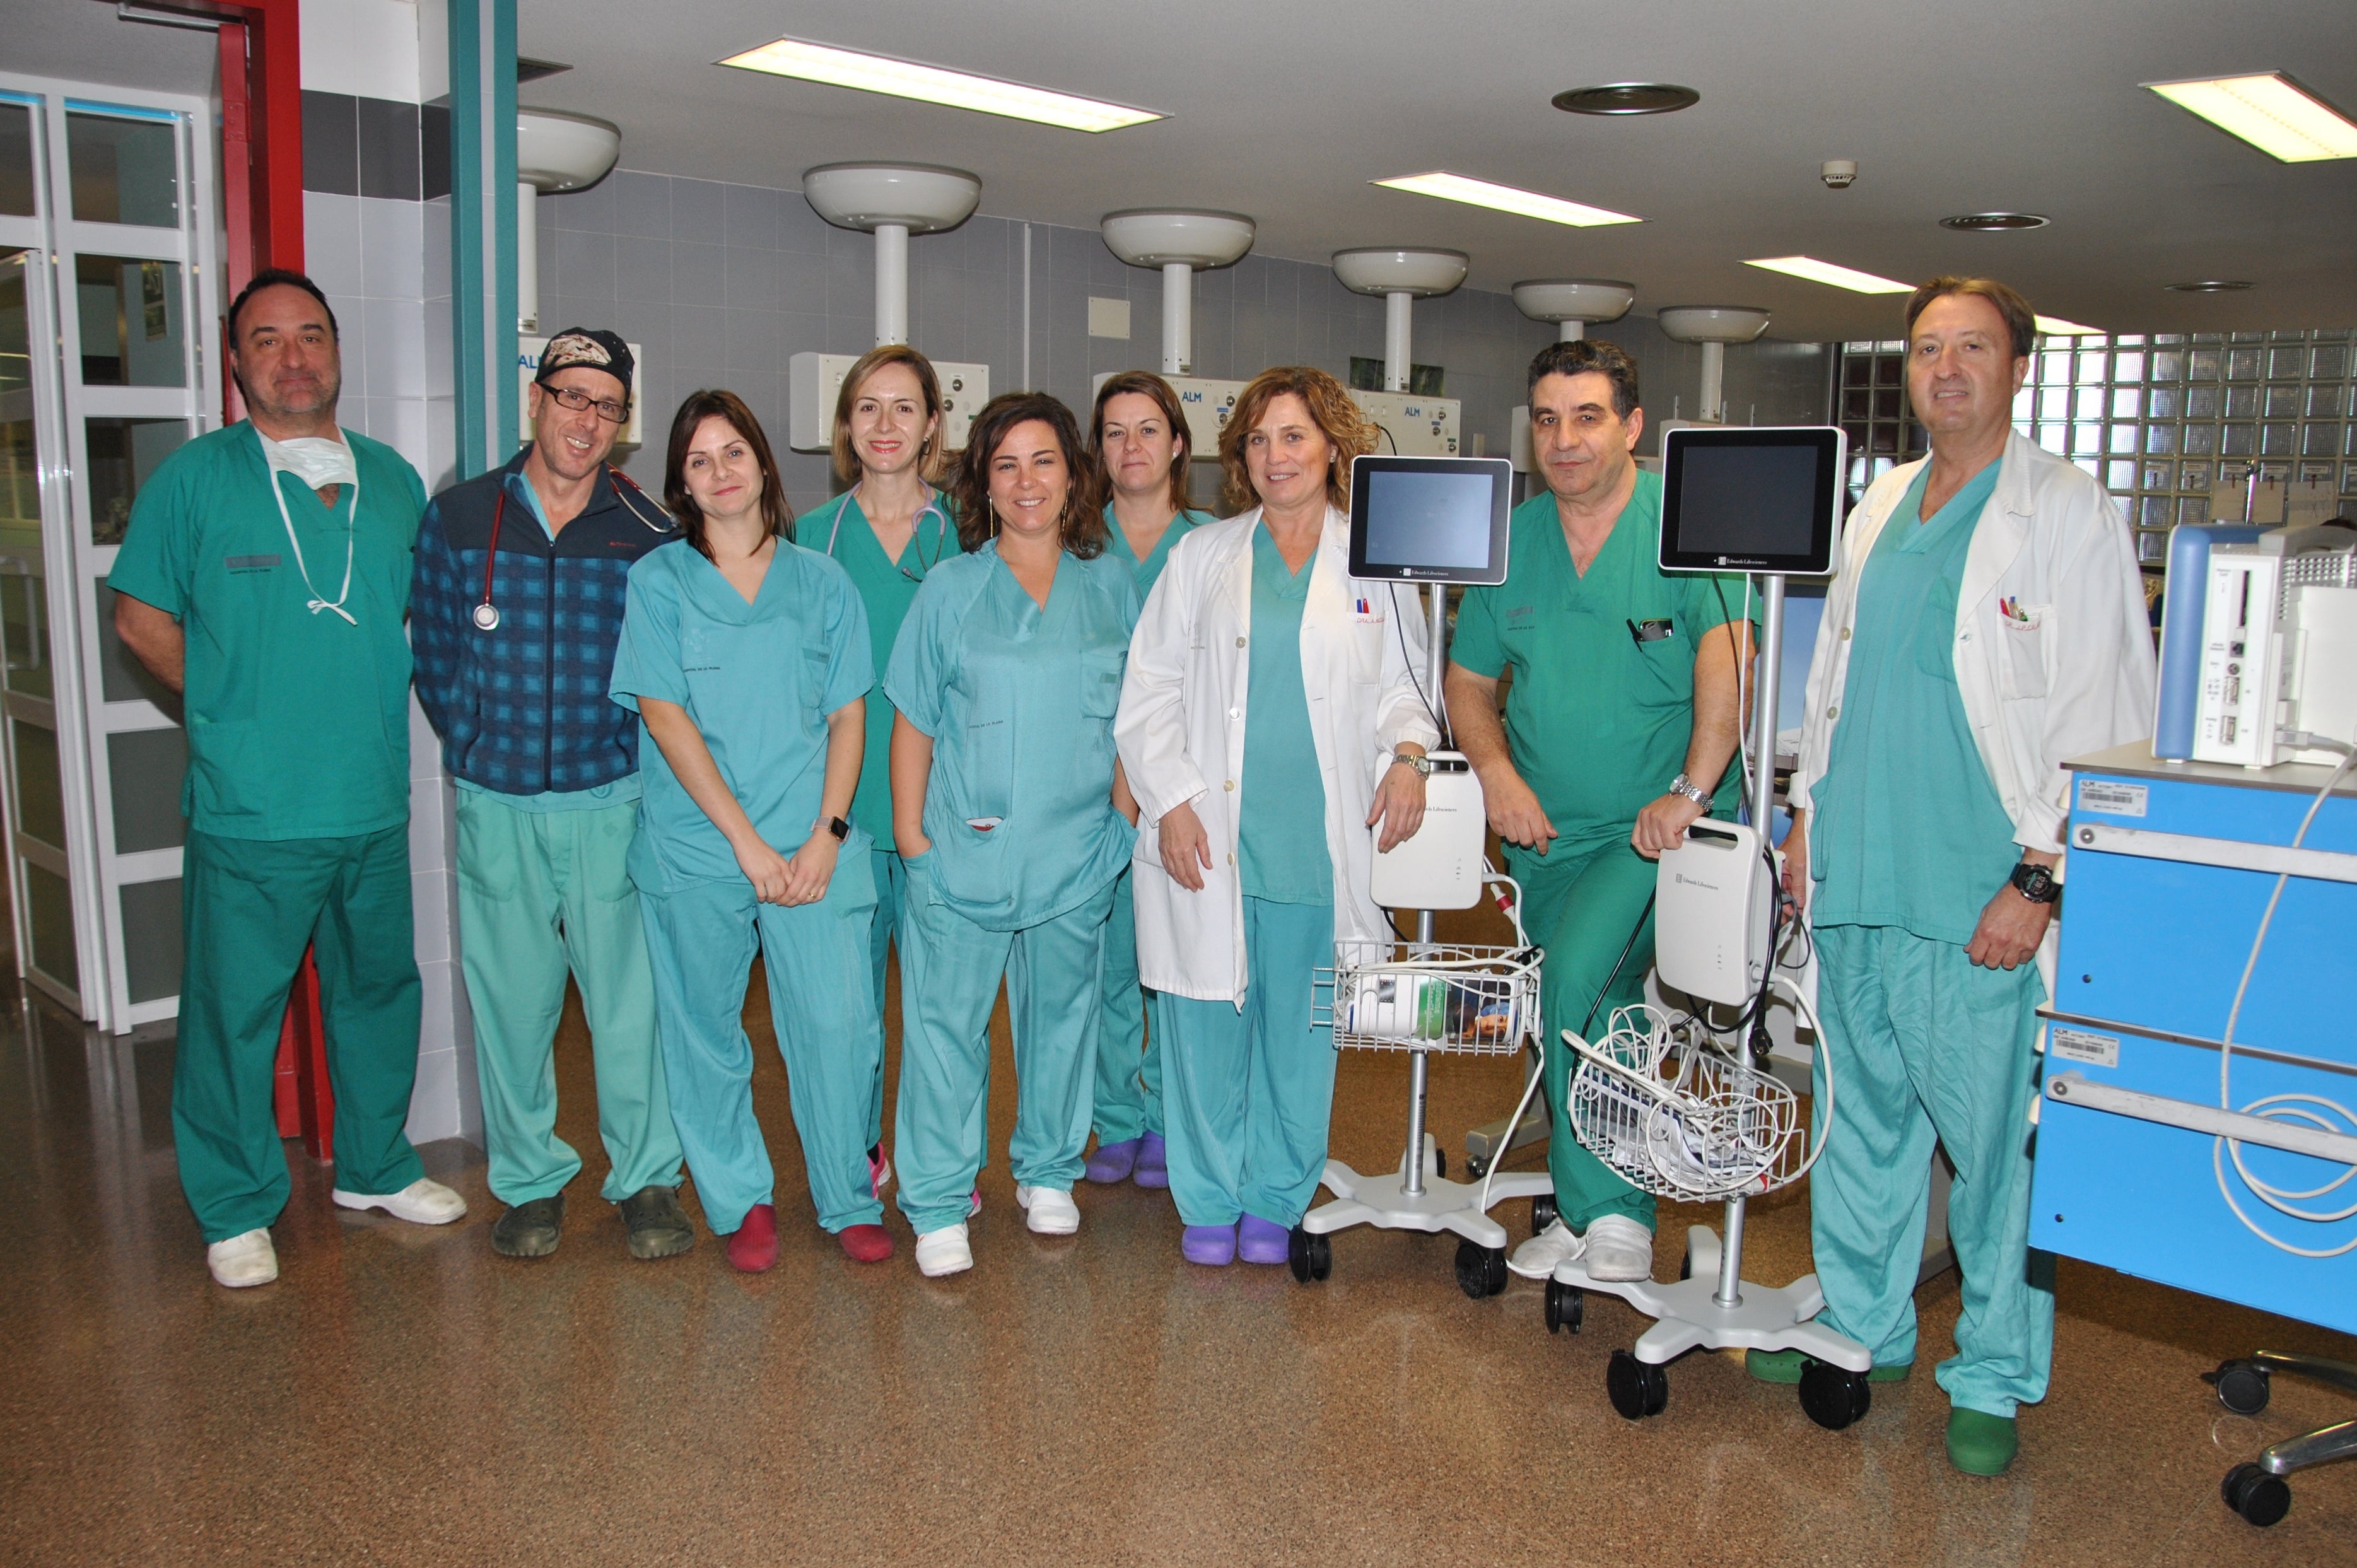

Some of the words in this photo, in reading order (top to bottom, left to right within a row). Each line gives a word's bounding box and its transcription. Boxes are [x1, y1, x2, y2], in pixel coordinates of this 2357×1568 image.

[518, 355, 541, 368] AL
[1181, 391, 1202, 402] ALM
[1404, 406, 1420, 417] ALM
[1683, 877, 1697, 886] Edwards
[1697, 881, 1719, 891] Lifesciences
